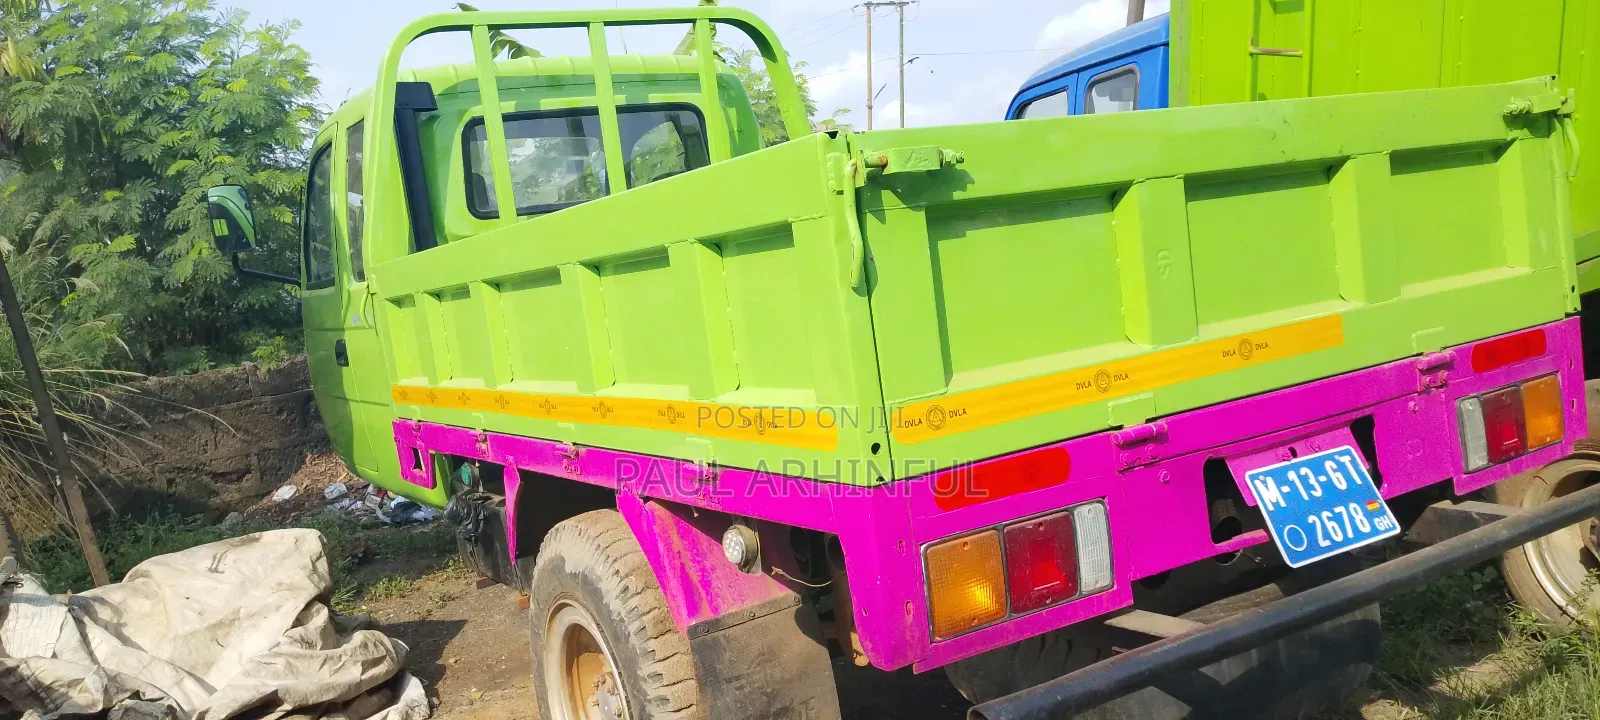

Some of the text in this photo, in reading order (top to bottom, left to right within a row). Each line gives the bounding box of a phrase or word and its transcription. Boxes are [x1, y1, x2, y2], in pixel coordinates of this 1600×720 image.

[1222, 341, 1269, 358] DVLA DVLA
[1076, 372, 1129, 391] DVLA DVLA
[904, 407, 967, 429] DVLA DVLA
[1254, 456, 1362, 511] M-13-GT
[1308, 503, 1392, 548] 2678 GH
